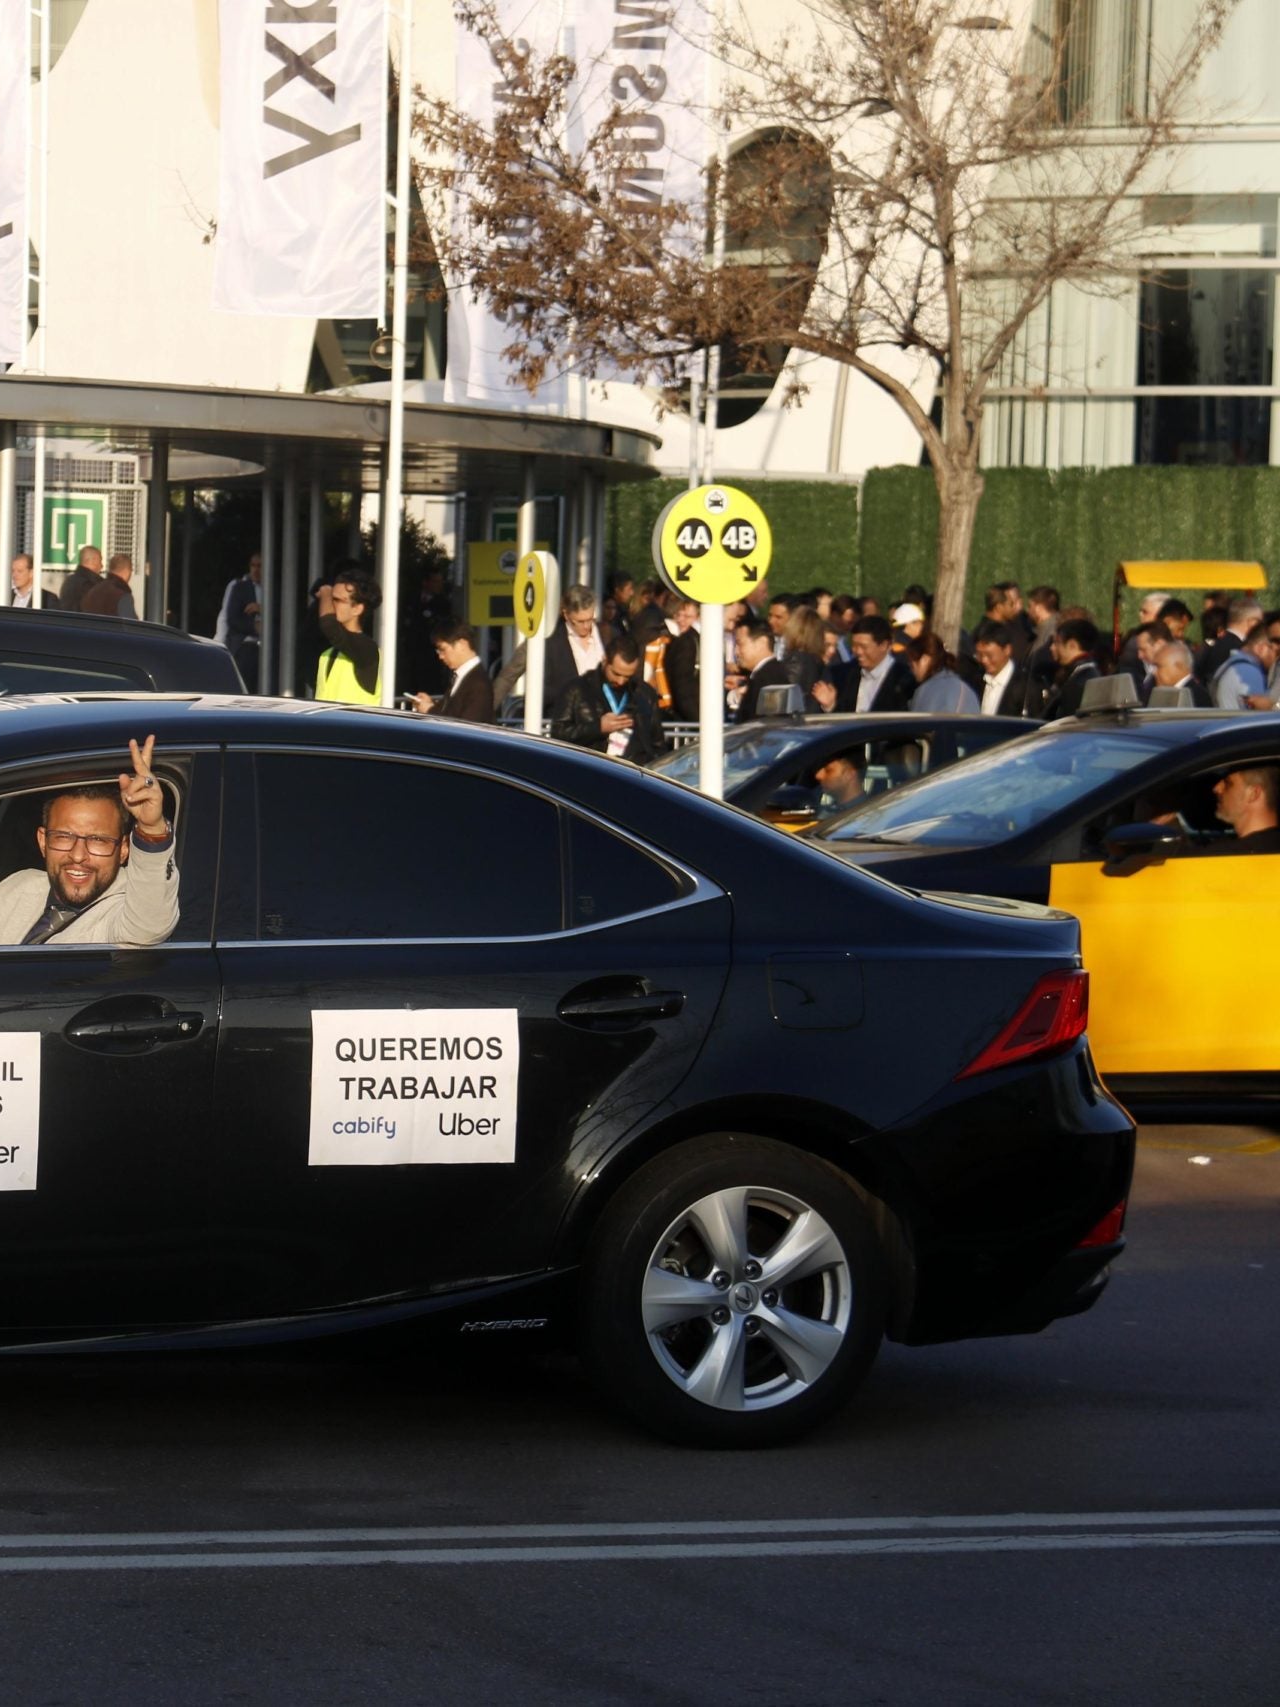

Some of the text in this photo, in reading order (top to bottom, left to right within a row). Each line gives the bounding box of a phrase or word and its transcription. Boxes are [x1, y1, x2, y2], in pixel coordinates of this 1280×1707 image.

[676, 525, 755, 550] 4A 4B
[335, 1036, 503, 1063] QUEREMOS
[339, 1075, 497, 1100] TRABAJAR
[332, 1112, 501, 1139] cabify Uber
[460, 1318, 548, 1332] HYBRID
